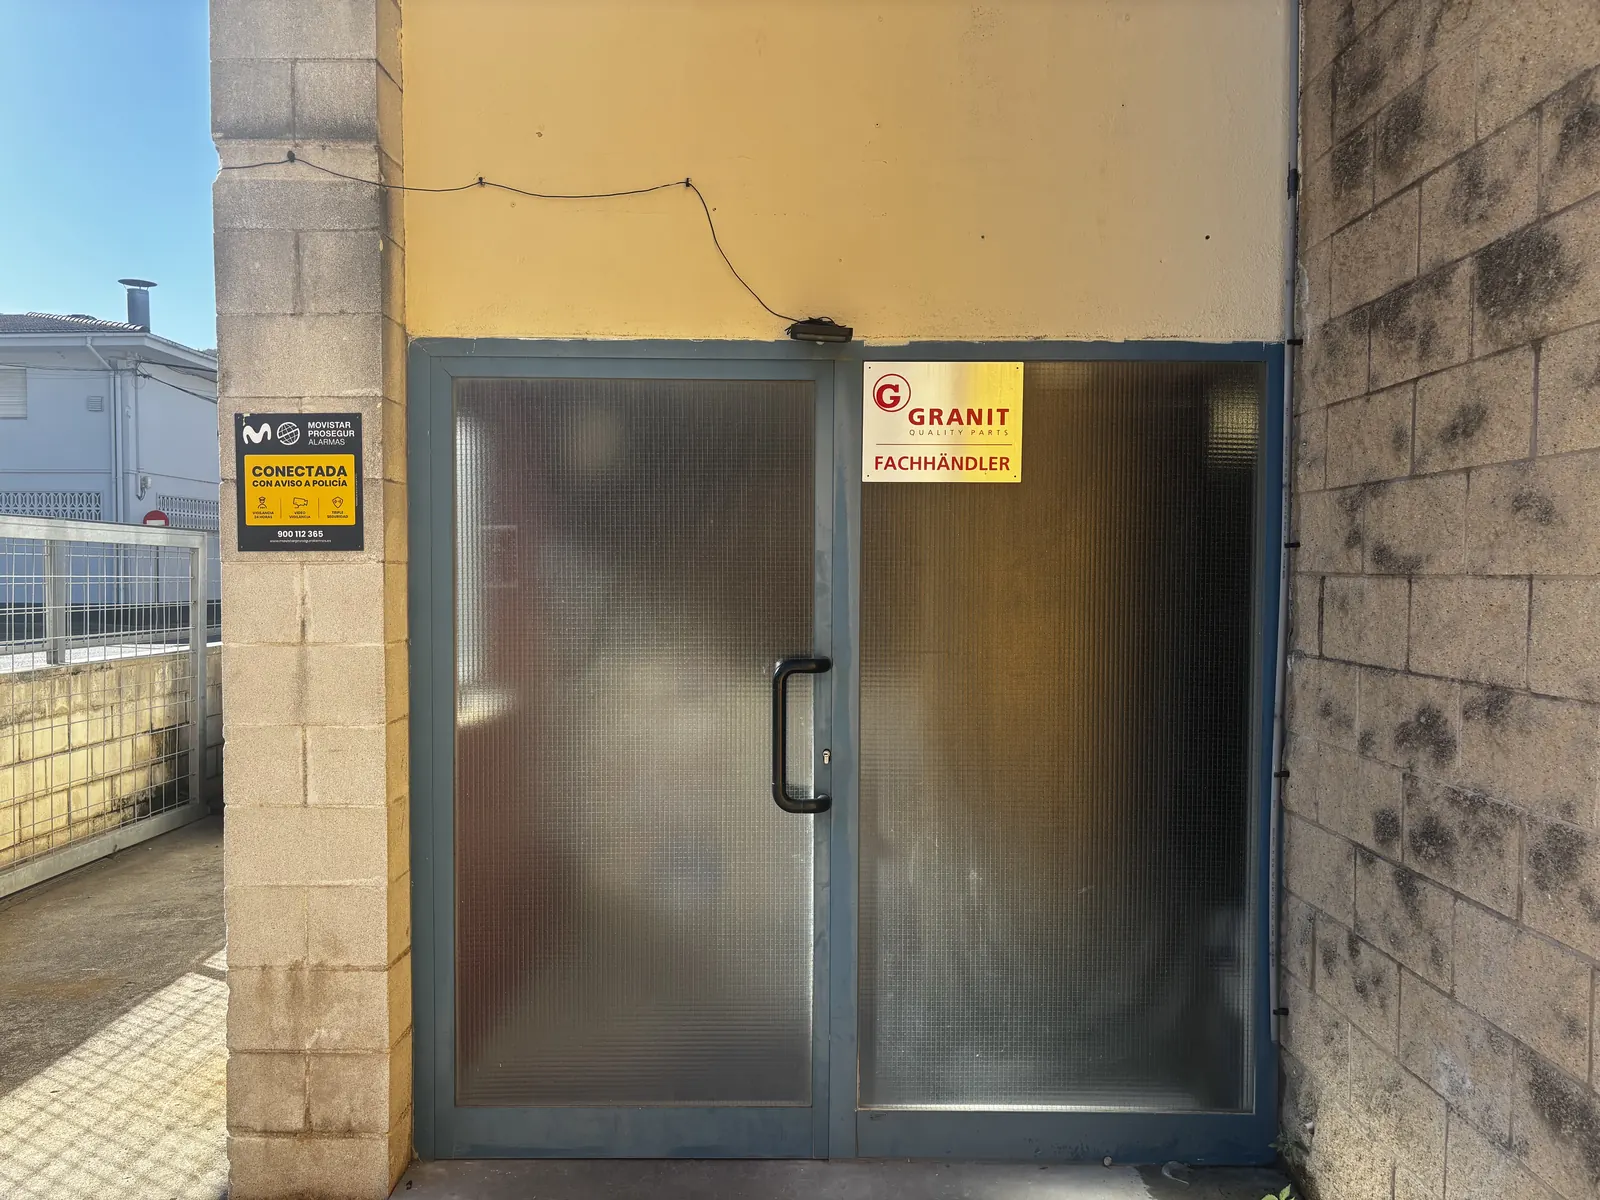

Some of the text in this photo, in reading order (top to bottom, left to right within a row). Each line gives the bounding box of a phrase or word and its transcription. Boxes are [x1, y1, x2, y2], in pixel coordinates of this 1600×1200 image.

[908, 407, 1010, 426] GRANIT
[307, 421, 351, 429] MOVISTAR
[307, 438, 346, 446] ALARMAS
[874, 453, 1010, 471] FACHHÄNDLER
[251, 465, 348, 477] CONECTADA
[312, 477, 348, 487] POLICÍA
[277, 530, 324, 538] 900 112 365
